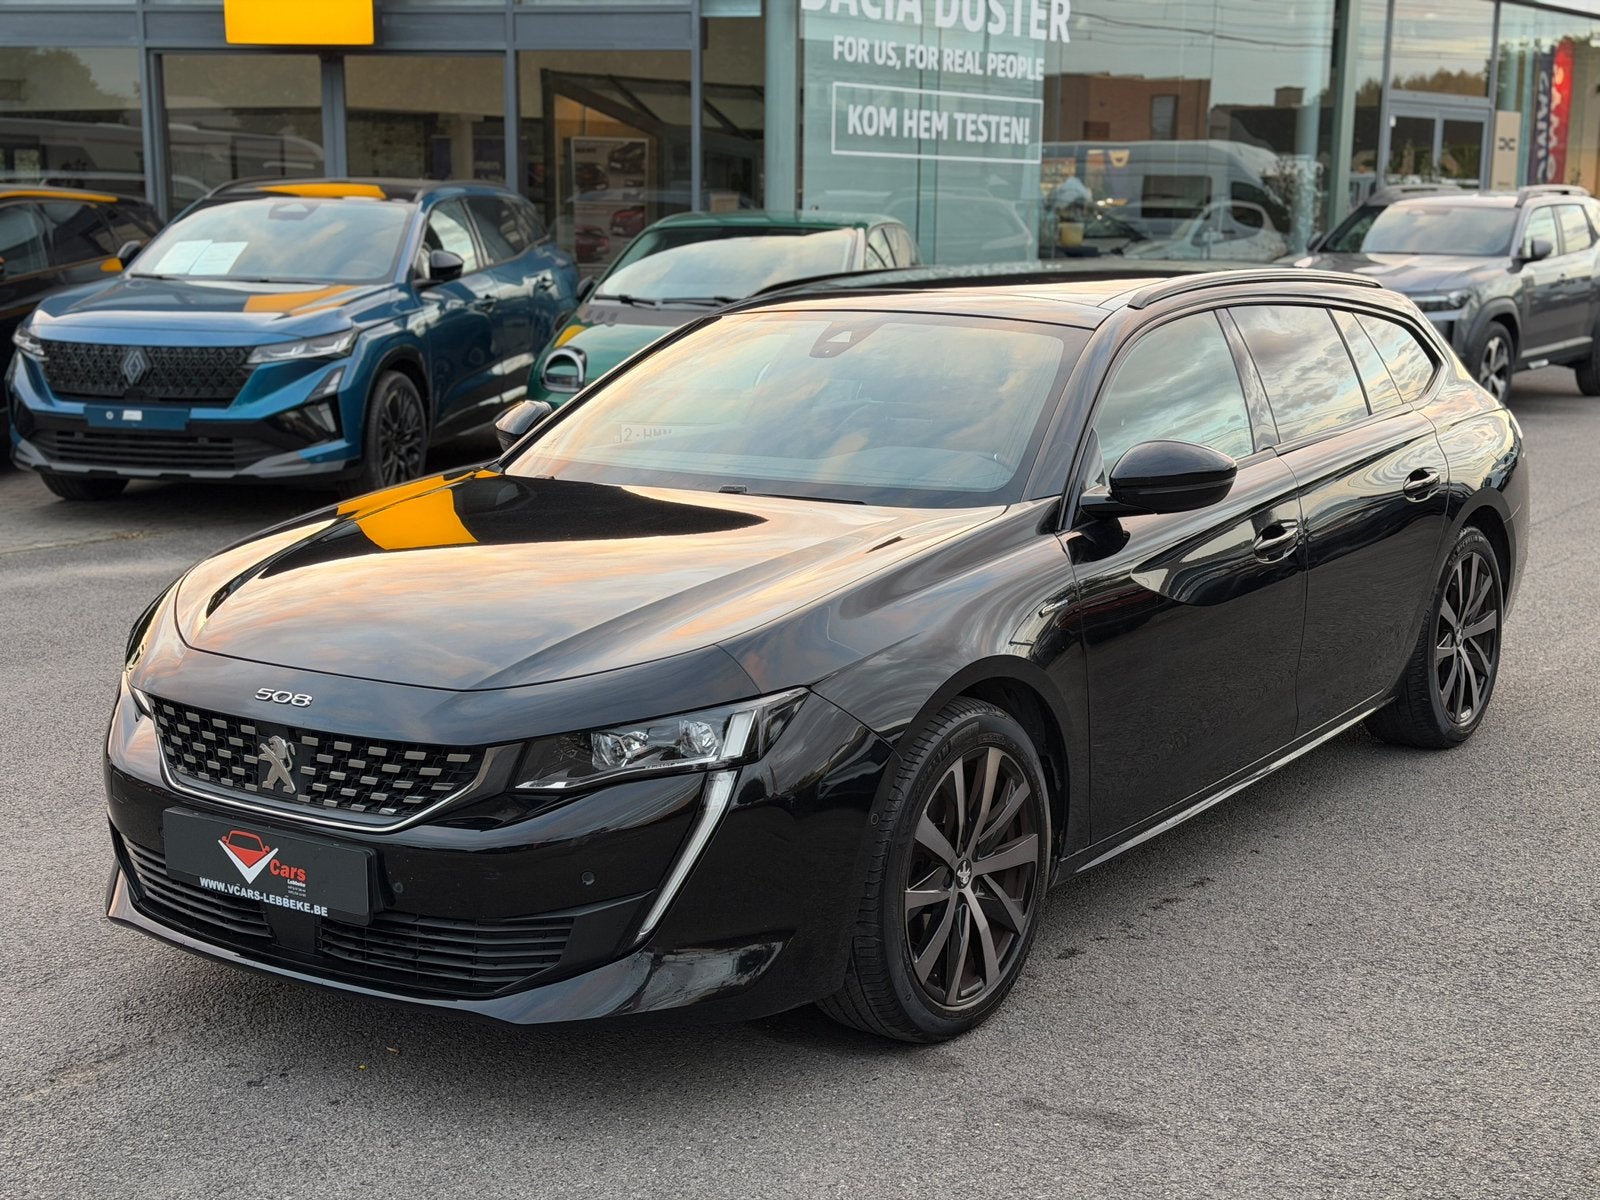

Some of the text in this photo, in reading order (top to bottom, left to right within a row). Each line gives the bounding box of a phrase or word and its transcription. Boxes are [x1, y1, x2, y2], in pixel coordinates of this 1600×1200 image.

[833, 35, 1045, 81] FOR US, FOR REAL PEOPLE
[848, 104, 1030, 145] KOM HEM TESTEN!
[255, 687, 313, 707] 508
[270, 858, 307, 882] Cars
[199, 876, 329, 917] WWW.VCARS-LEBBEKE.BE
